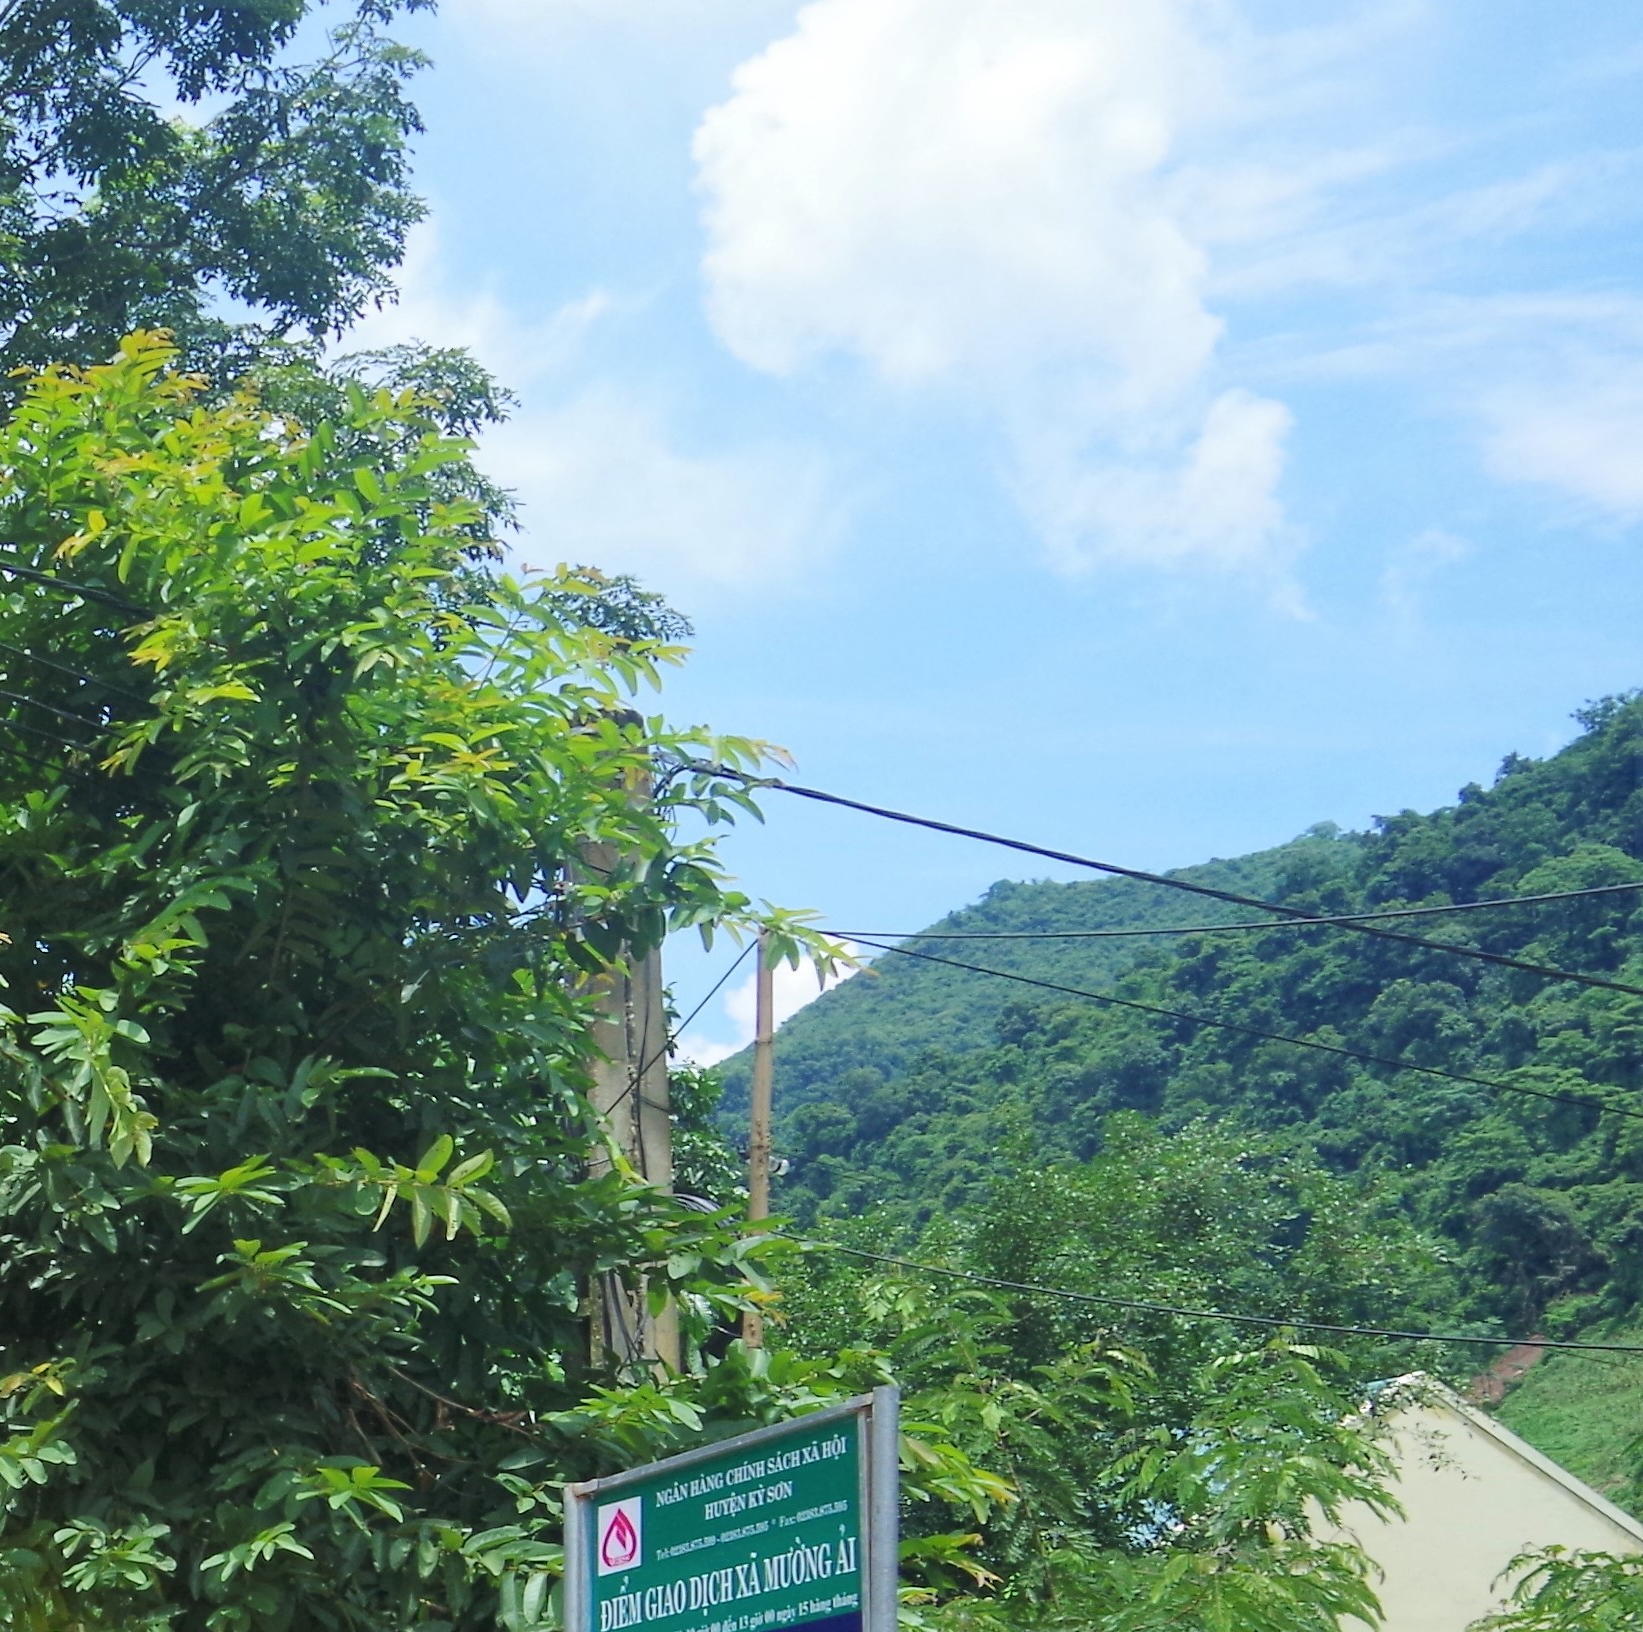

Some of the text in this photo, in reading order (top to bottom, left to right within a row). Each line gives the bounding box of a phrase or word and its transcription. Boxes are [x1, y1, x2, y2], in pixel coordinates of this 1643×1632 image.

[655, 1434, 847, 1508] NGÂN HÀNG CHÍNH SÁCH XÃ HỘI
[704, 1481, 793, 1520] HUYỆN KỲ SƠN
[600, 1576, 642, 1632] ĐIỂM
[645, 1580, 685, 1621] GIAO
[689, 1567, 733, 1617] DỊCH
[736, 1552, 761, 1599] XÃ
[763, 1536, 832, 1593] MƯỜNG
[835, 1524, 857, 1576] ẢI
